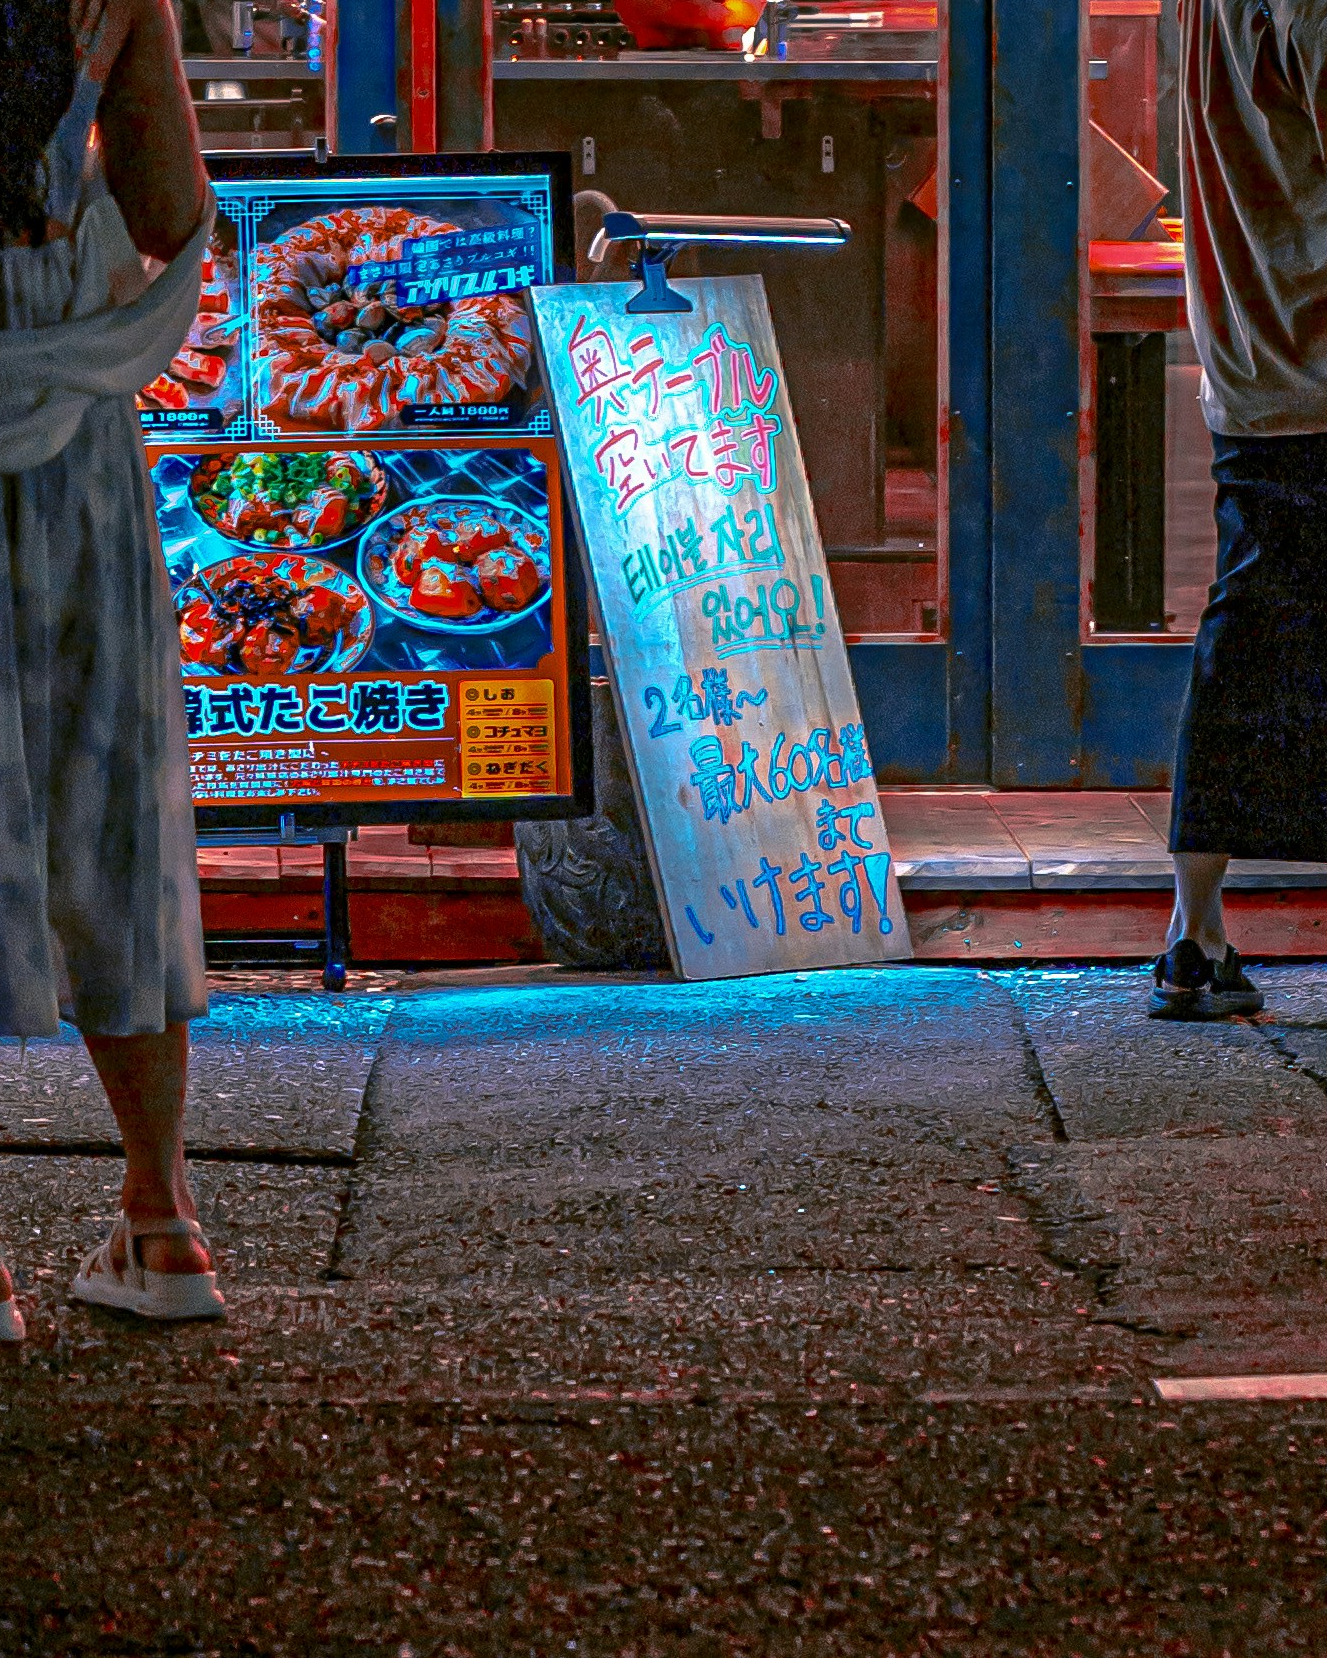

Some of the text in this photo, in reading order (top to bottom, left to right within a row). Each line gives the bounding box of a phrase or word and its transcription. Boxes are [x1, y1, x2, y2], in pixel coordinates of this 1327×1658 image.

[568, 314, 774, 425] 奥テーブル
[594, 414, 776, 510] 空いてます
[621, 503, 786, 604] 테이블 자리
[701, 574, 826, 644] 있어요!
[688, 722, 873, 824] 最大60名様
[815, 798, 875, 851] まで
[684, 850, 893, 946] いけます!
